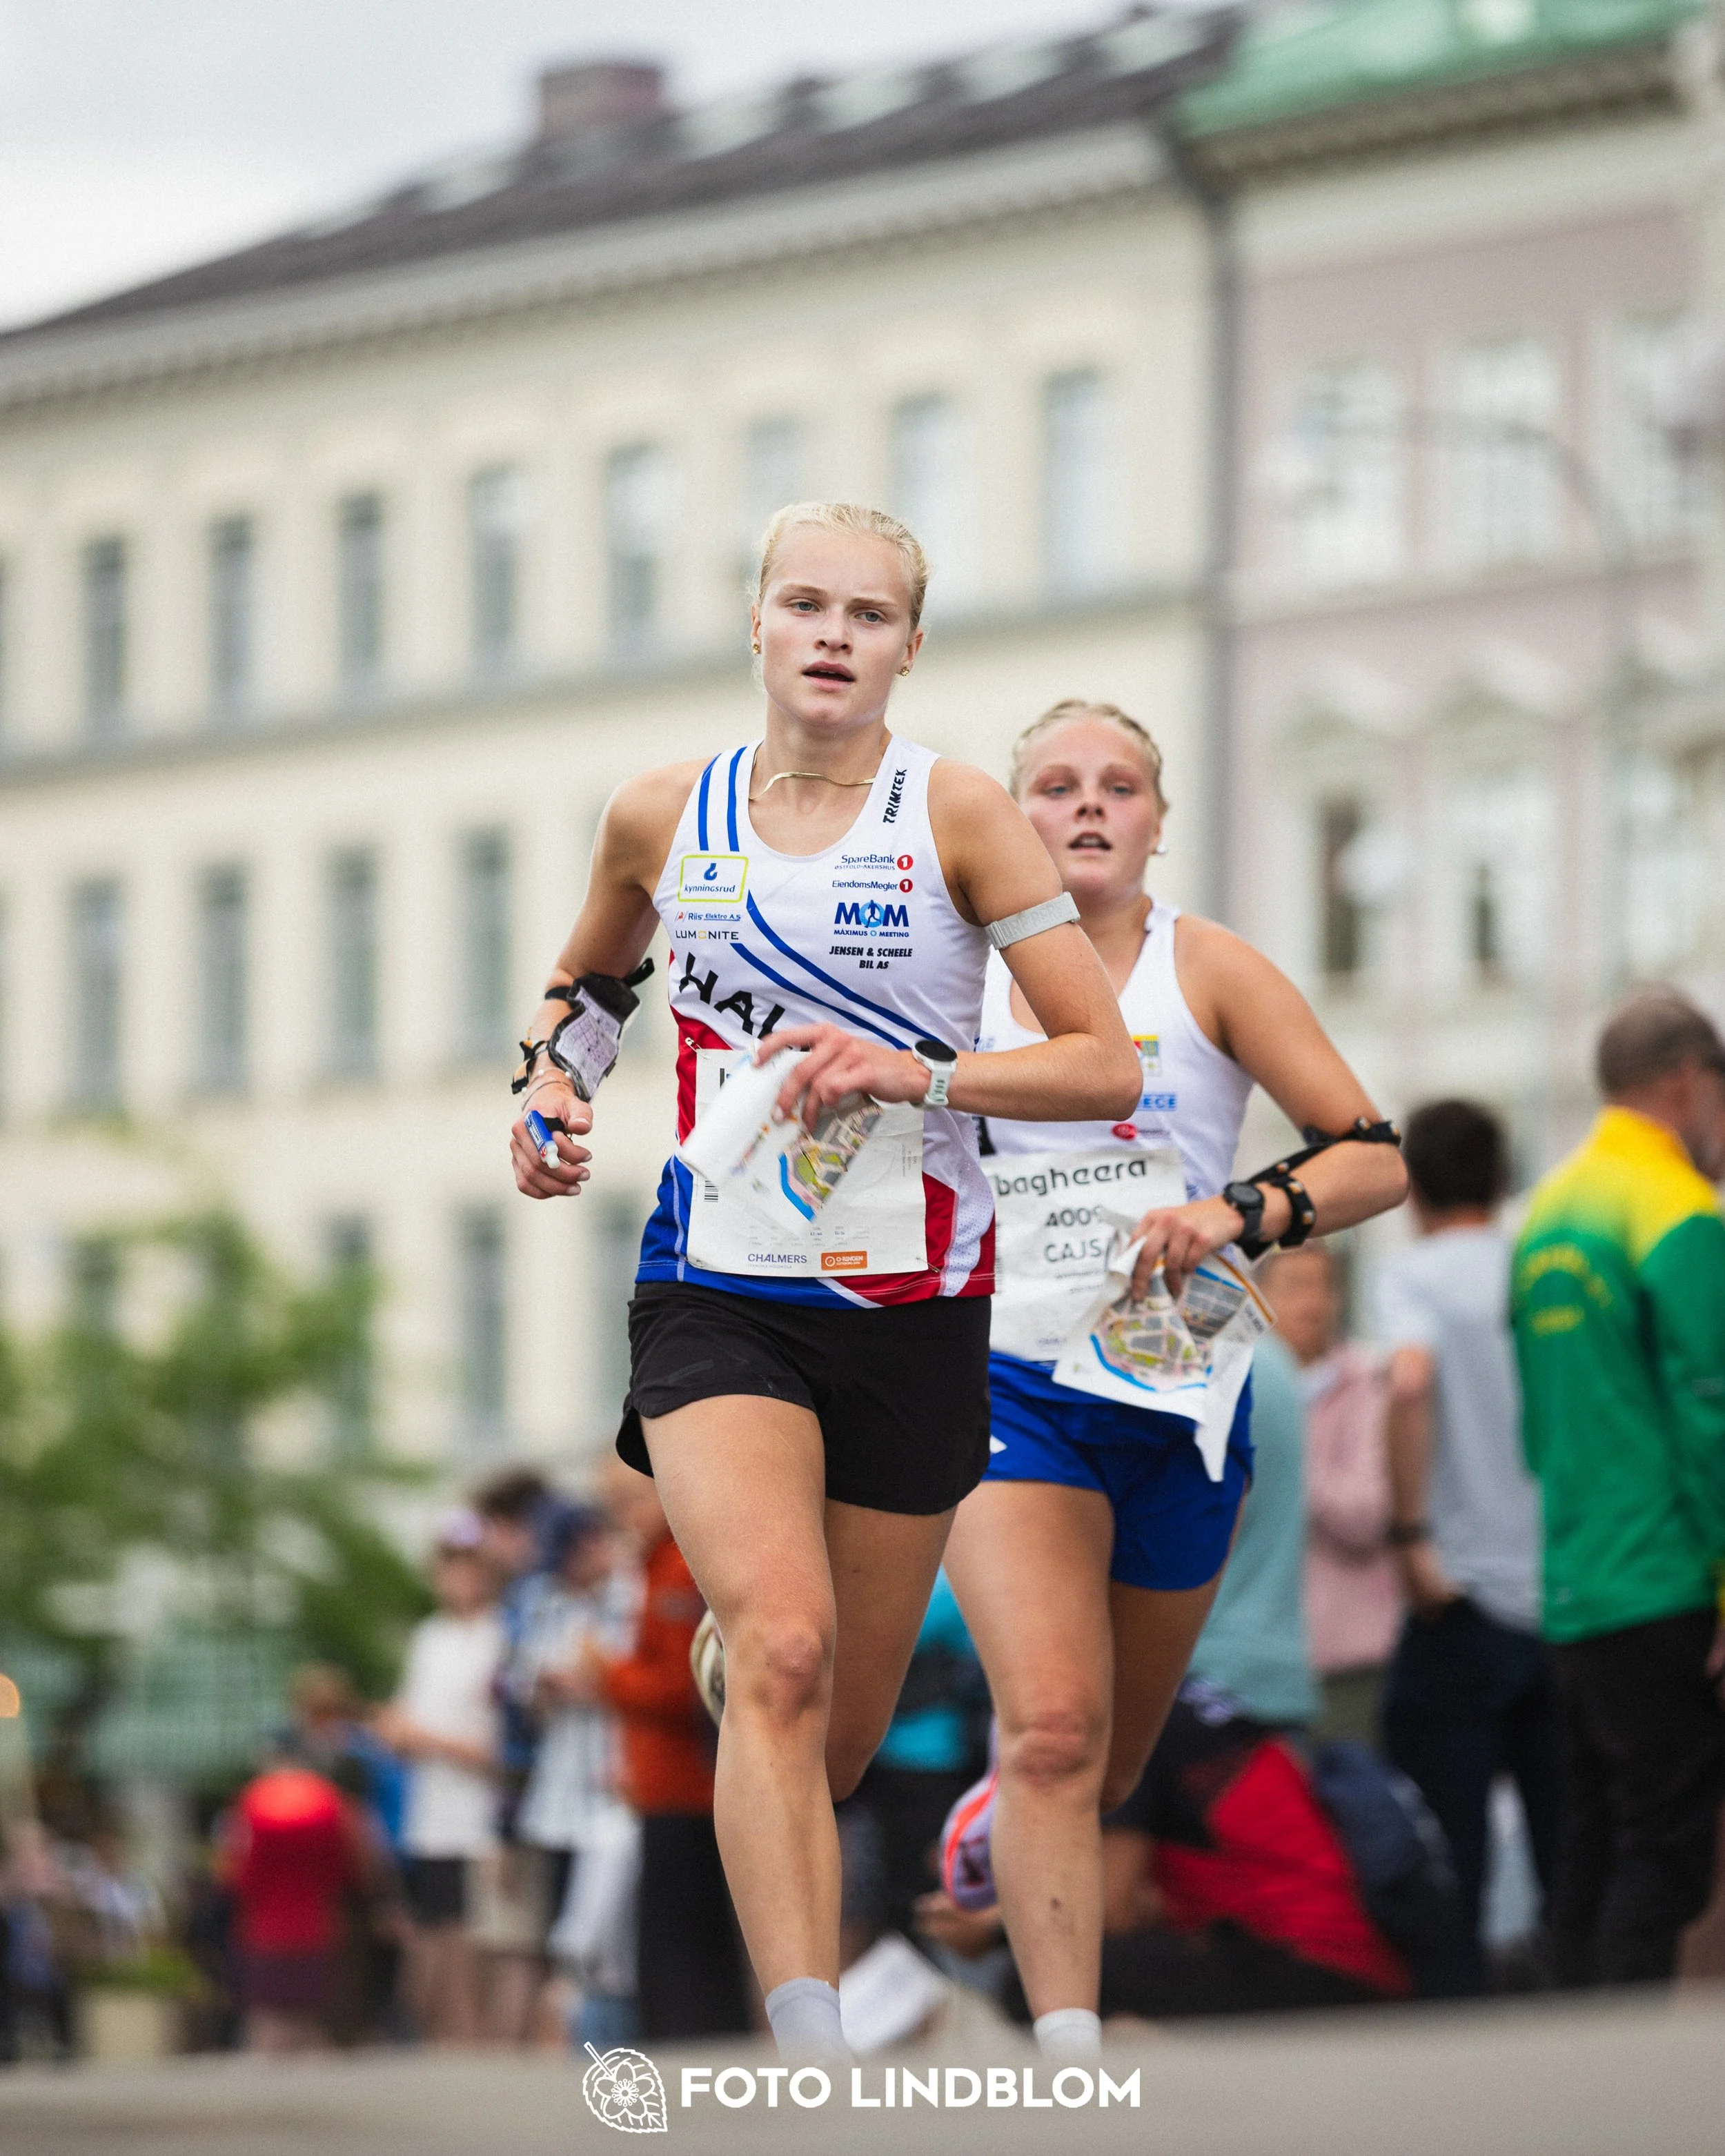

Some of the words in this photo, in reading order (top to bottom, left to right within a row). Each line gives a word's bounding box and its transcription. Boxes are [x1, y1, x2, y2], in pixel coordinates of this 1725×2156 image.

[841, 854, 895, 864] SpareBank
[684, 884, 736, 893] kynningsrud
[832, 880, 898, 891] EiendomsMegler
[834, 900, 909, 928] MOM
[676, 929, 739, 940] LUMONITE
[829, 946, 864, 956] JENSEN
[866, 947, 874, 957] &
[877, 948, 913, 957] SCHEELE
[859, 960, 874, 969] BIL
[876, 960, 889, 969] AS
[996, 1159, 1146, 1196] bagheera
[1044, 1239, 1102, 1262] CAJS
[747, 1254, 807, 1263] CHALMERS
